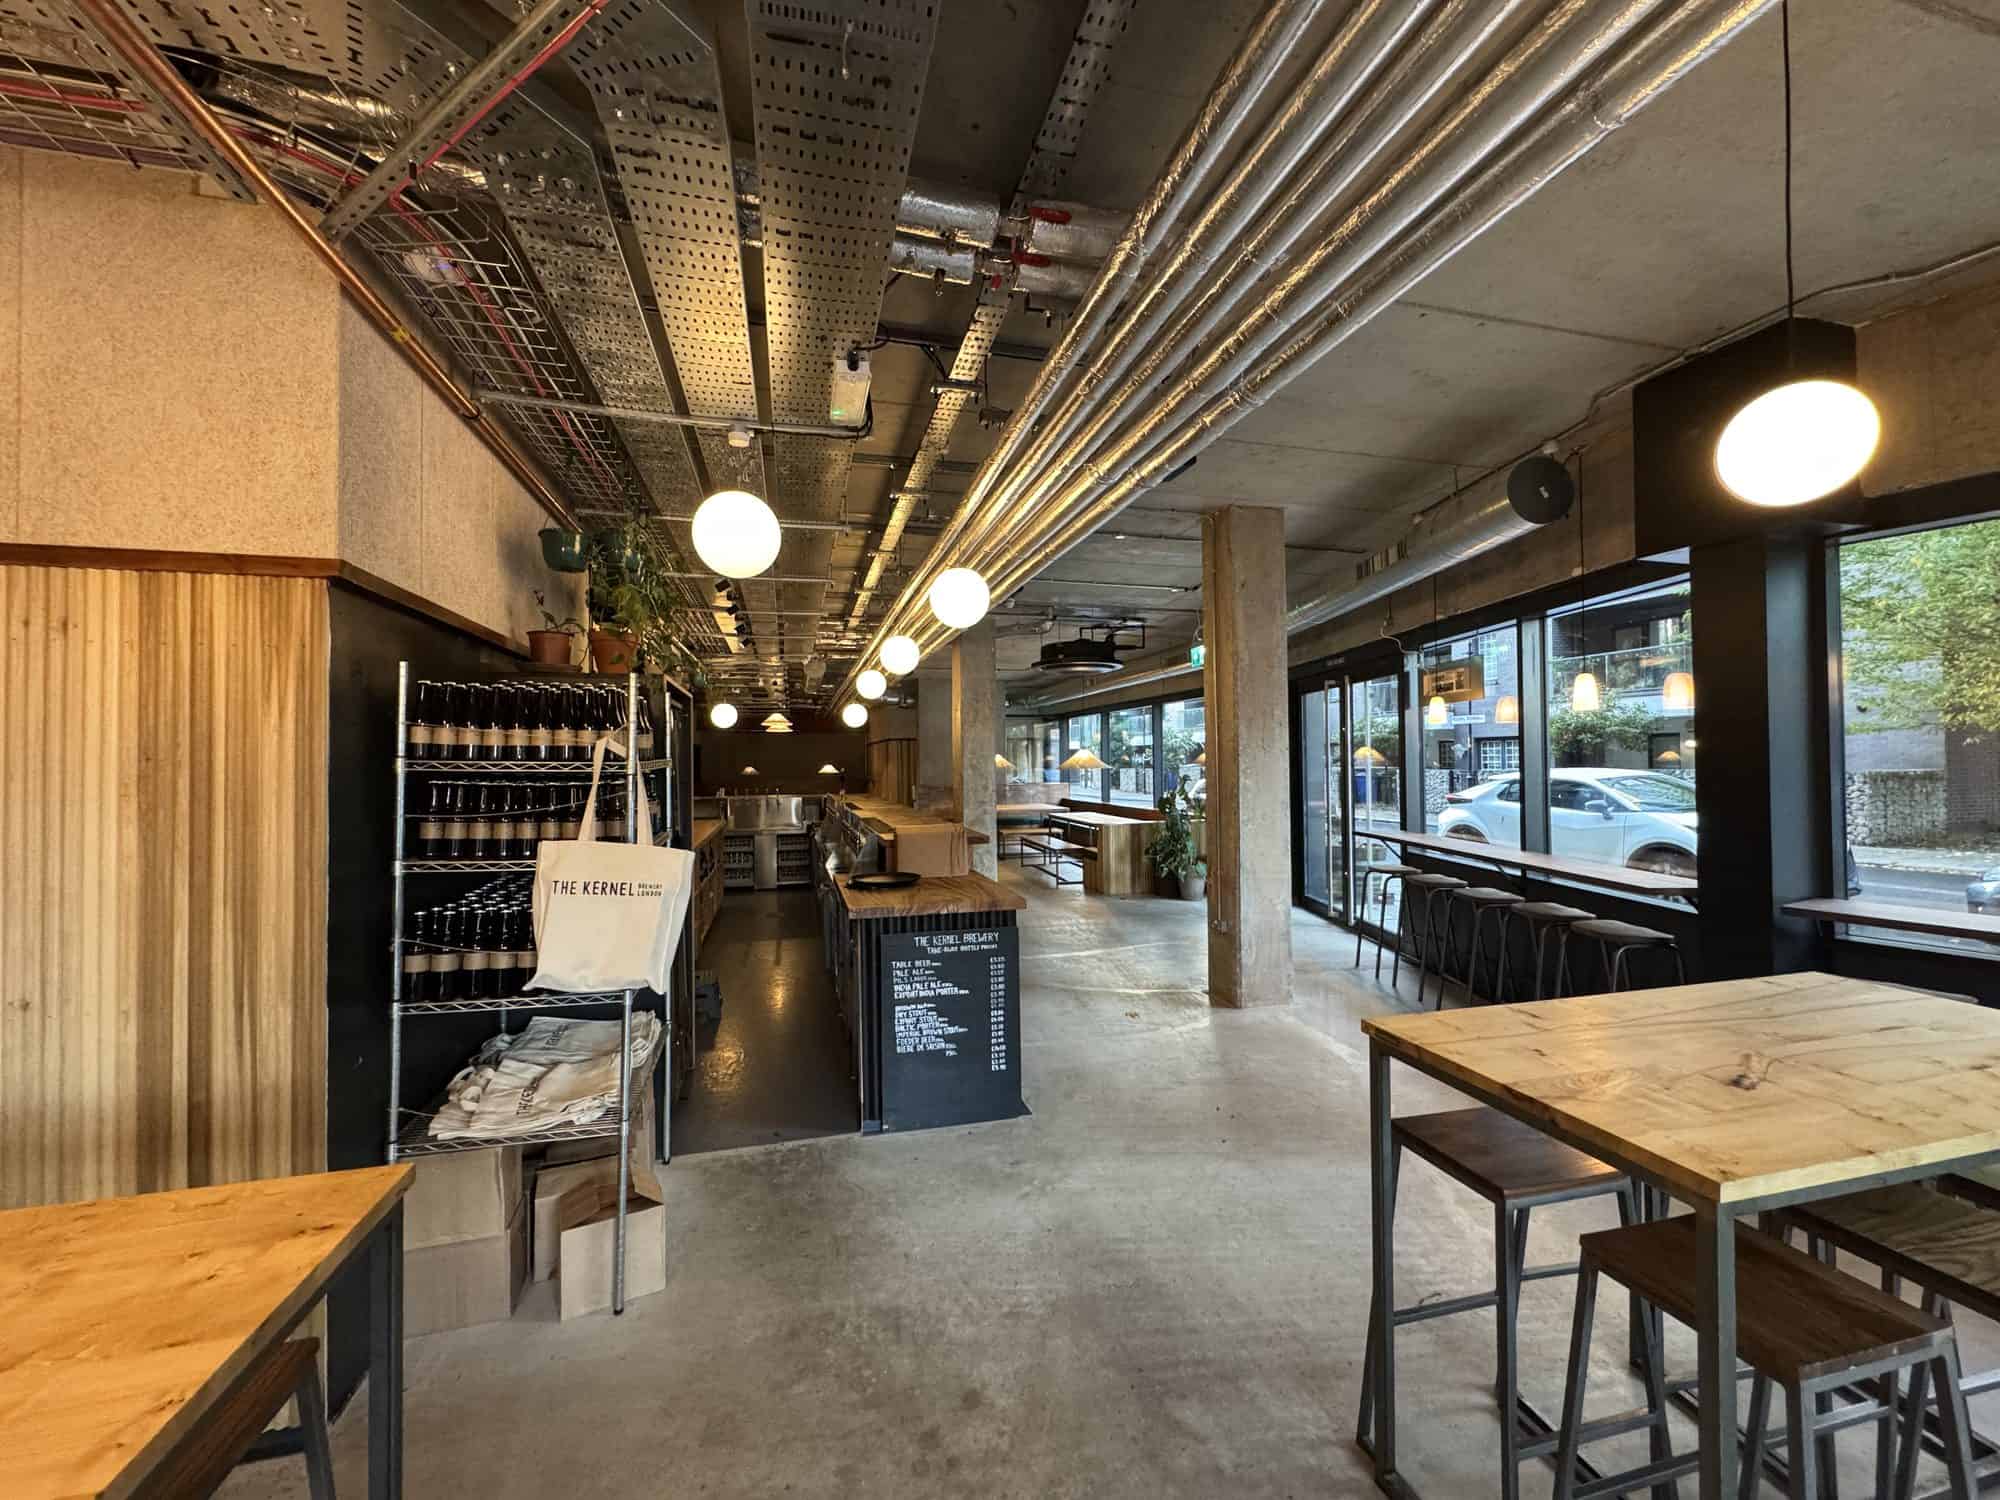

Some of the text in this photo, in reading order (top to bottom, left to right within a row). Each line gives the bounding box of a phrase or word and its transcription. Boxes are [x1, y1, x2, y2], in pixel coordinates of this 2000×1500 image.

[552, 880, 634, 896] THE KERNEL
[914, 932, 999, 947] THE KERNEL BREWERY
[891, 961, 912, 969] TABLE
[914, 959, 931, 968] BEER
[893, 969, 909, 977] PALE
[912, 982, 929, 990] PALE
